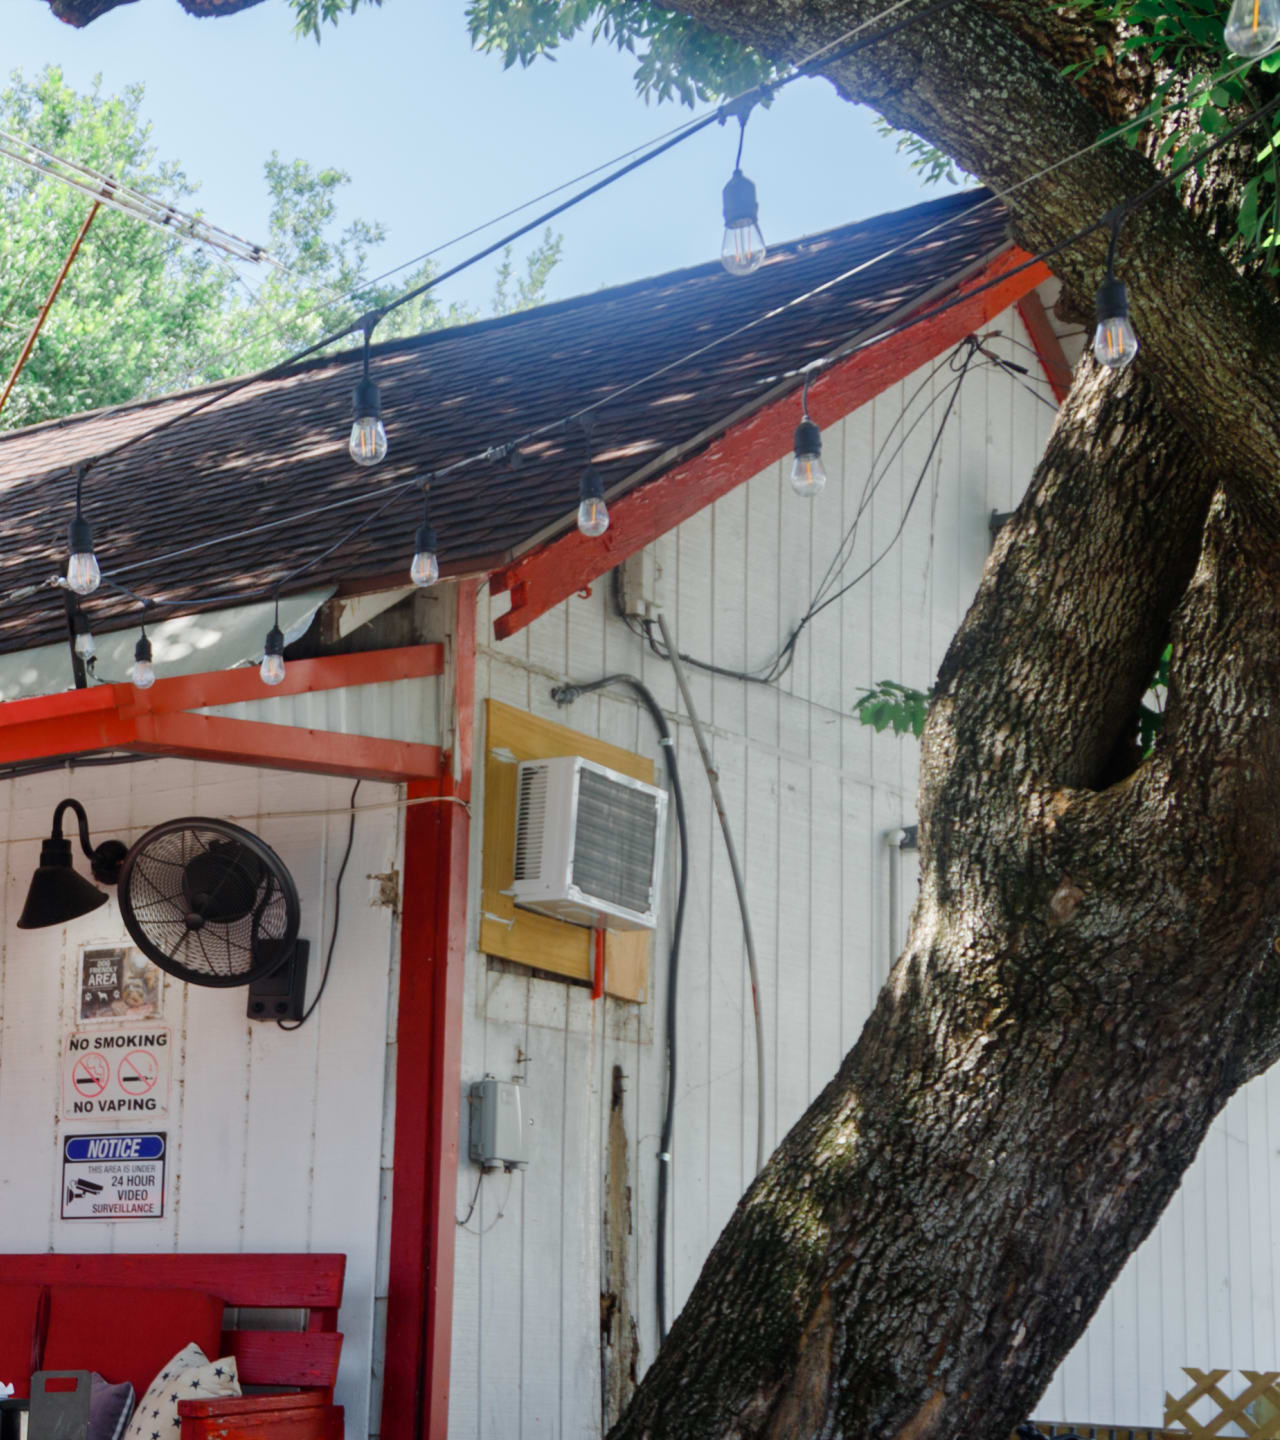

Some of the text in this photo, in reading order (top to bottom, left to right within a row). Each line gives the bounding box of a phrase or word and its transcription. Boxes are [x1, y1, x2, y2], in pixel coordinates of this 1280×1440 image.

[89, 966, 118, 974] FRIENDLY
[88, 973, 118, 986] AREA
[69, 1033, 167, 1051] NO SMOKING
[73, 1098, 157, 1113] NO VAPING
[87, 1138, 142, 1158] NOTICE
[88, 1164, 156, 1174] THIS AREA IS UNDER
[111, 1175, 156, 1187] 24 HOUR
[117, 1189, 149, 1201] VIDEO
[92, 1203, 155, 1214] SURVEILLANCE
